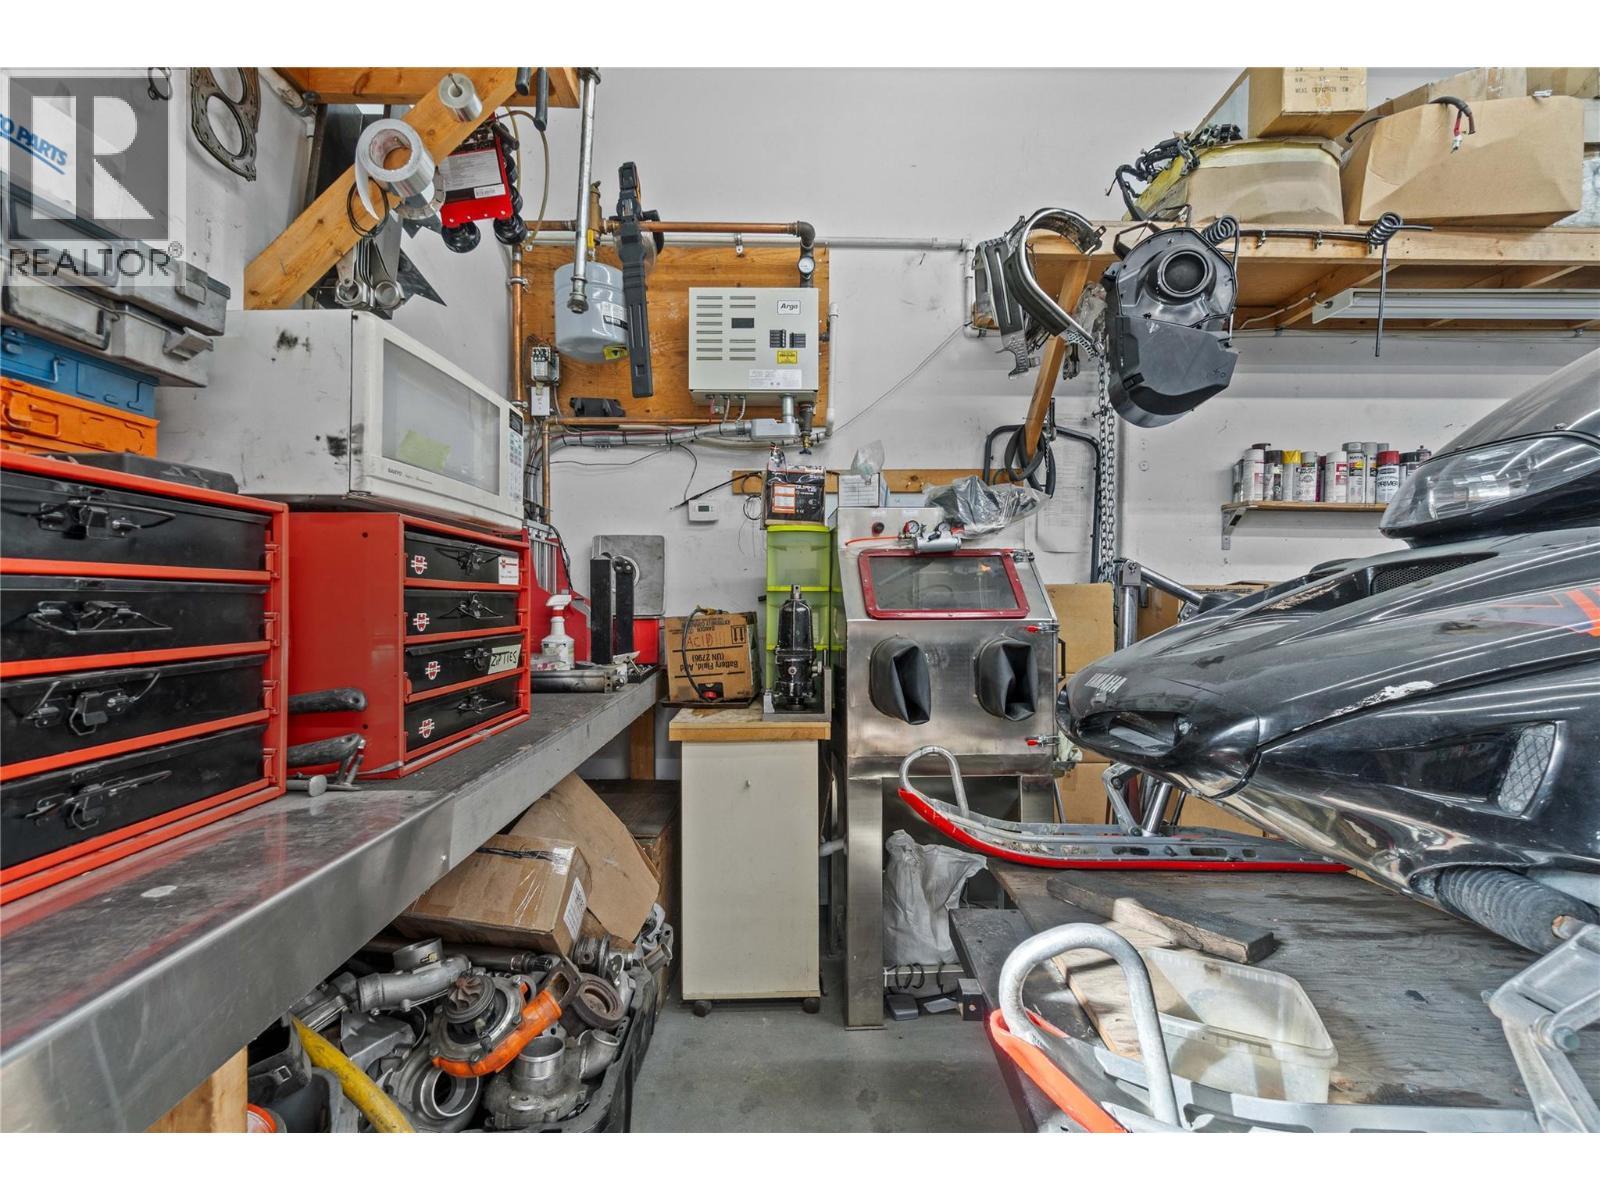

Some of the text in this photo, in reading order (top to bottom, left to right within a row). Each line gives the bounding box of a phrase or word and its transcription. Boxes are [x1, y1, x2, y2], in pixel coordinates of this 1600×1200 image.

[16, 125, 68, 166] PARTS
[502, 650, 517, 664] TIES
[680, 663, 694, 672] Ad
[715, 660, 738, 669] Battery
